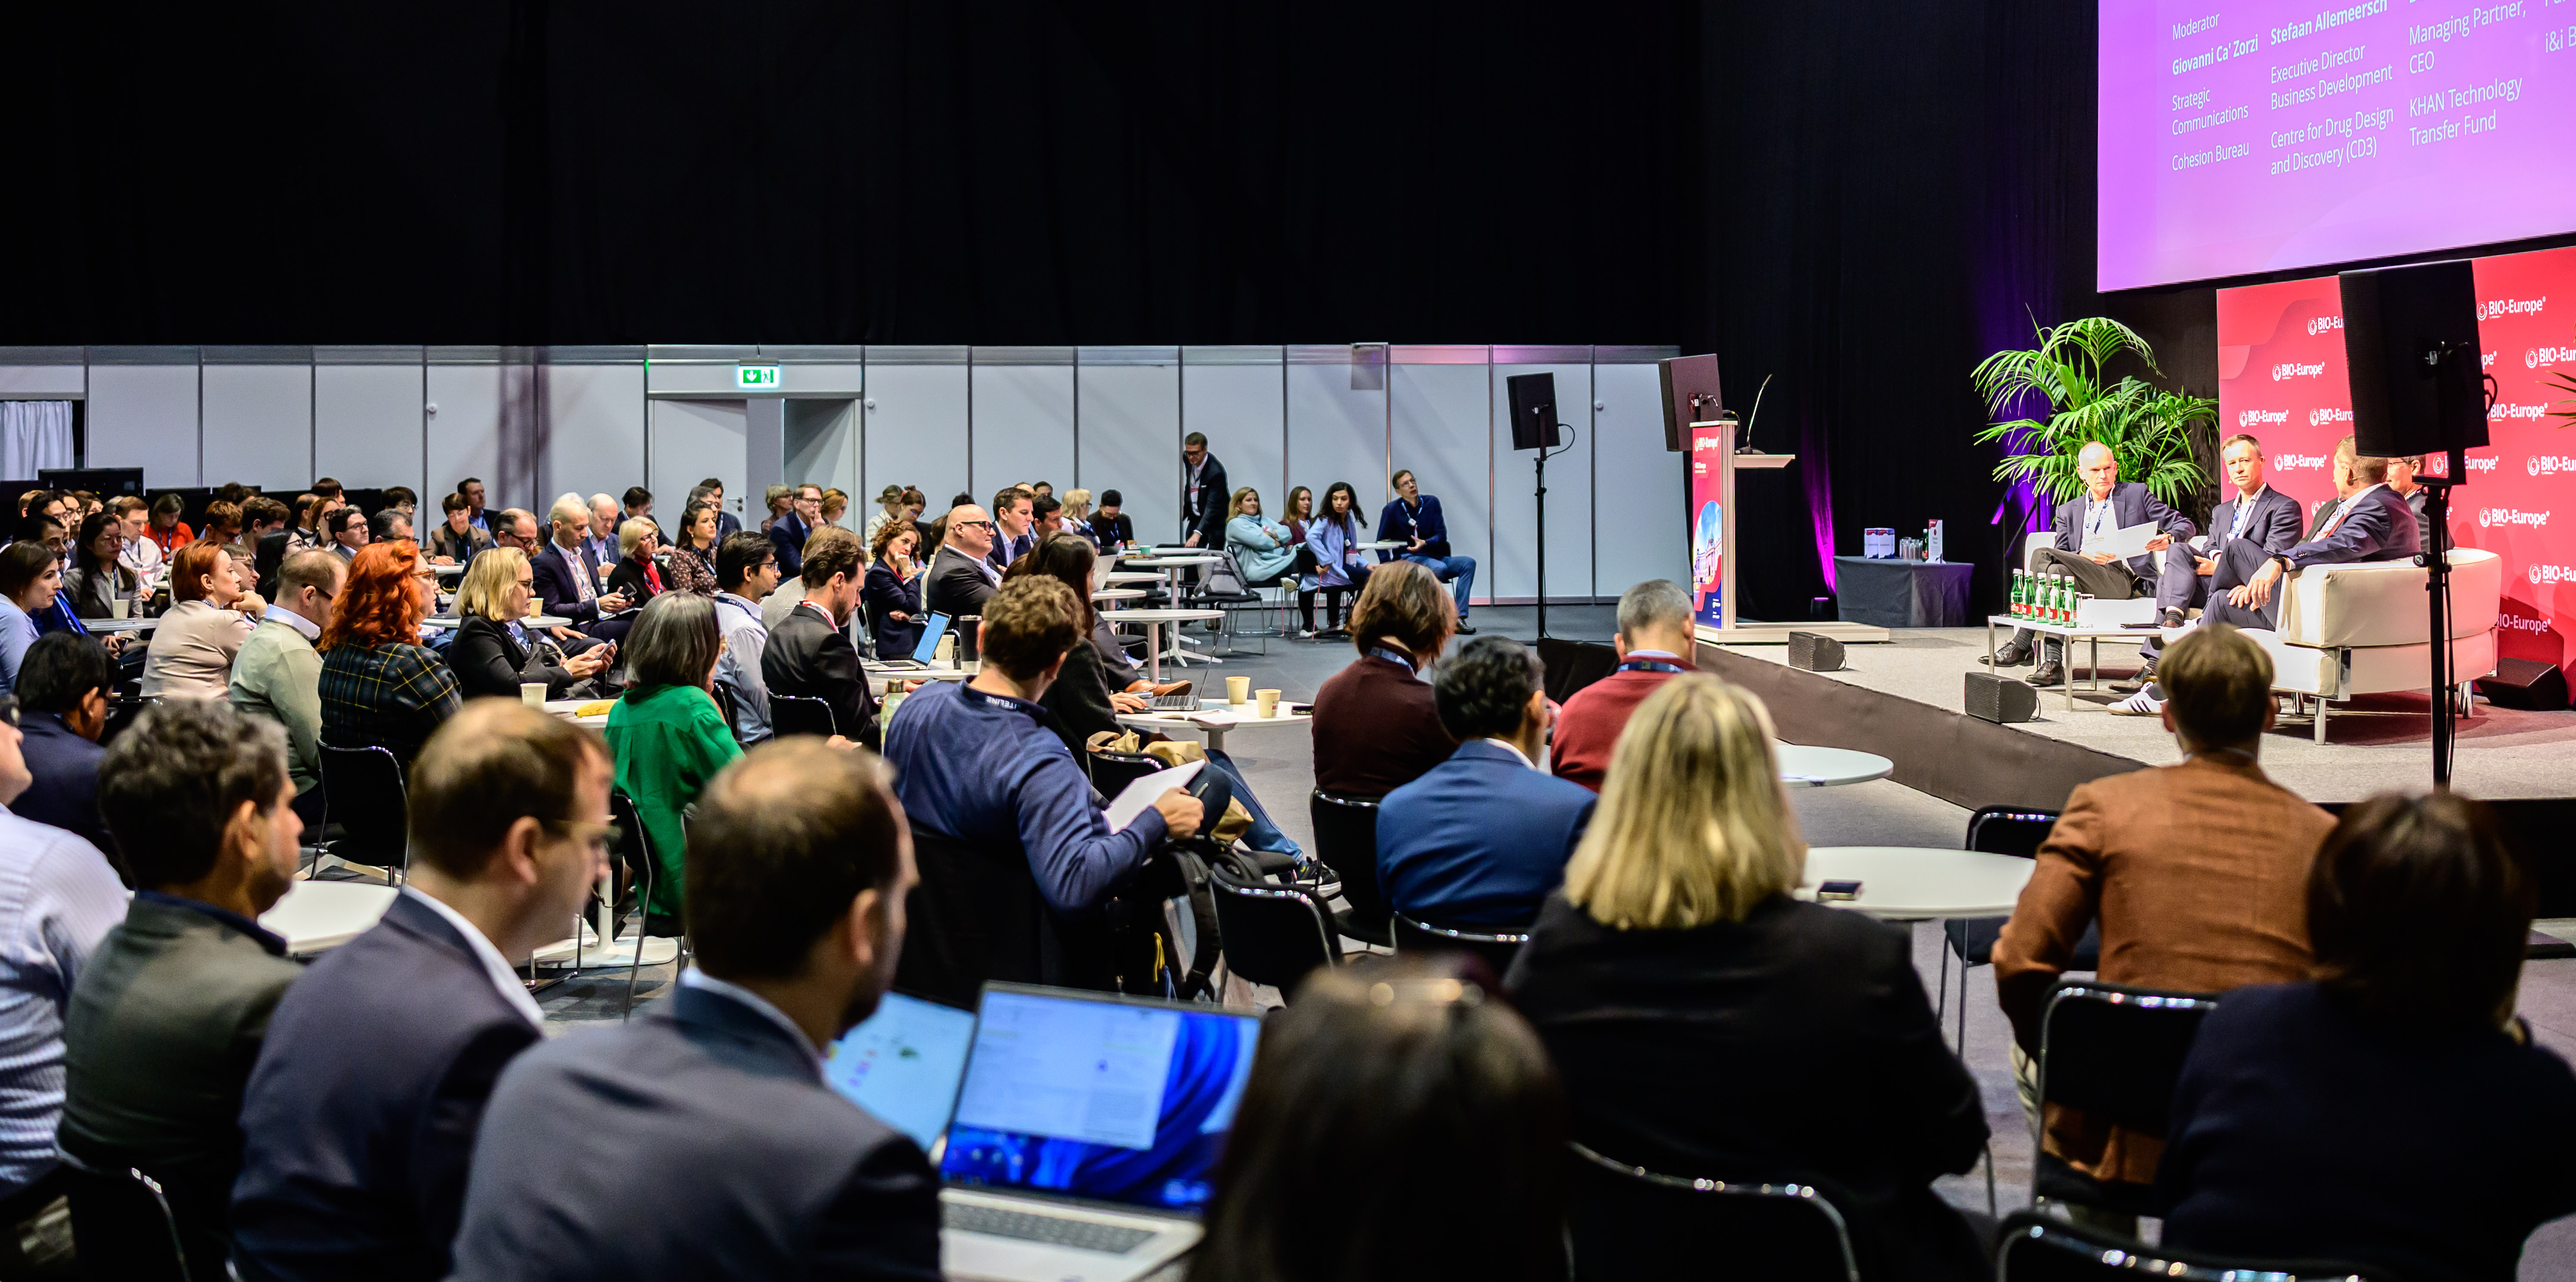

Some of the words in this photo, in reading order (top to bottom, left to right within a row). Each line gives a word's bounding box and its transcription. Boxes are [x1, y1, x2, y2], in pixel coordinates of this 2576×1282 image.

[2172, 13, 2220, 40] Moderator
[2271, 21, 2312, 45] Stefaan
[2314, 0, 2387, 32] Allemeersch
[2410, 15, 2470, 46] Managing
[2474, 0, 2526, 28] Partner,
[2172, 48, 2214, 75] Giovanni
[2216, 43, 2231, 62] Ca'
[2233, 34, 2258, 58] Zorzi
[2545, 29, 2563, 53] i&i
[2271, 58, 2318, 84] Executive
[2321, 45, 2366, 70] Director
[2410, 50, 2434, 74] CEO
[2172, 87, 2210, 111] Strategic
[2271, 86, 2315, 110] Business
[2319, 64, 2393, 98] Development
[2410, 91, 2444, 118] KHAN
[2448, 77, 2522, 108] Technology
[2172, 105, 2249, 135] Communications
[2271, 129, 2305, 148] Centre
[2307, 122, 2323, 141] for
[2326, 118, 2352, 138] Drug
[2355, 107, 2394, 130] Design
[2409, 119, 2460, 147] Transfer
[2465, 109, 2496, 135] Fund
[2172, 150, 2213, 171] Cohesion
[2216, 142, 2249, 162] Bureau
[2271, 154, 2289, 175] and
[2293, 148, 2344, 171] Discovery
[2346, 136, 2377, 163] (CD3)
[2317, 316, 2343, 330] BIO-Eu
[2539, 347, 2576, 363] BIO-Eur
[2319, 408, 2354, 421] BIO-Euro
[2541, 456, 2576, 471] BIO-Eu
[2542, 565, 2576, 581] BIO-Eu
